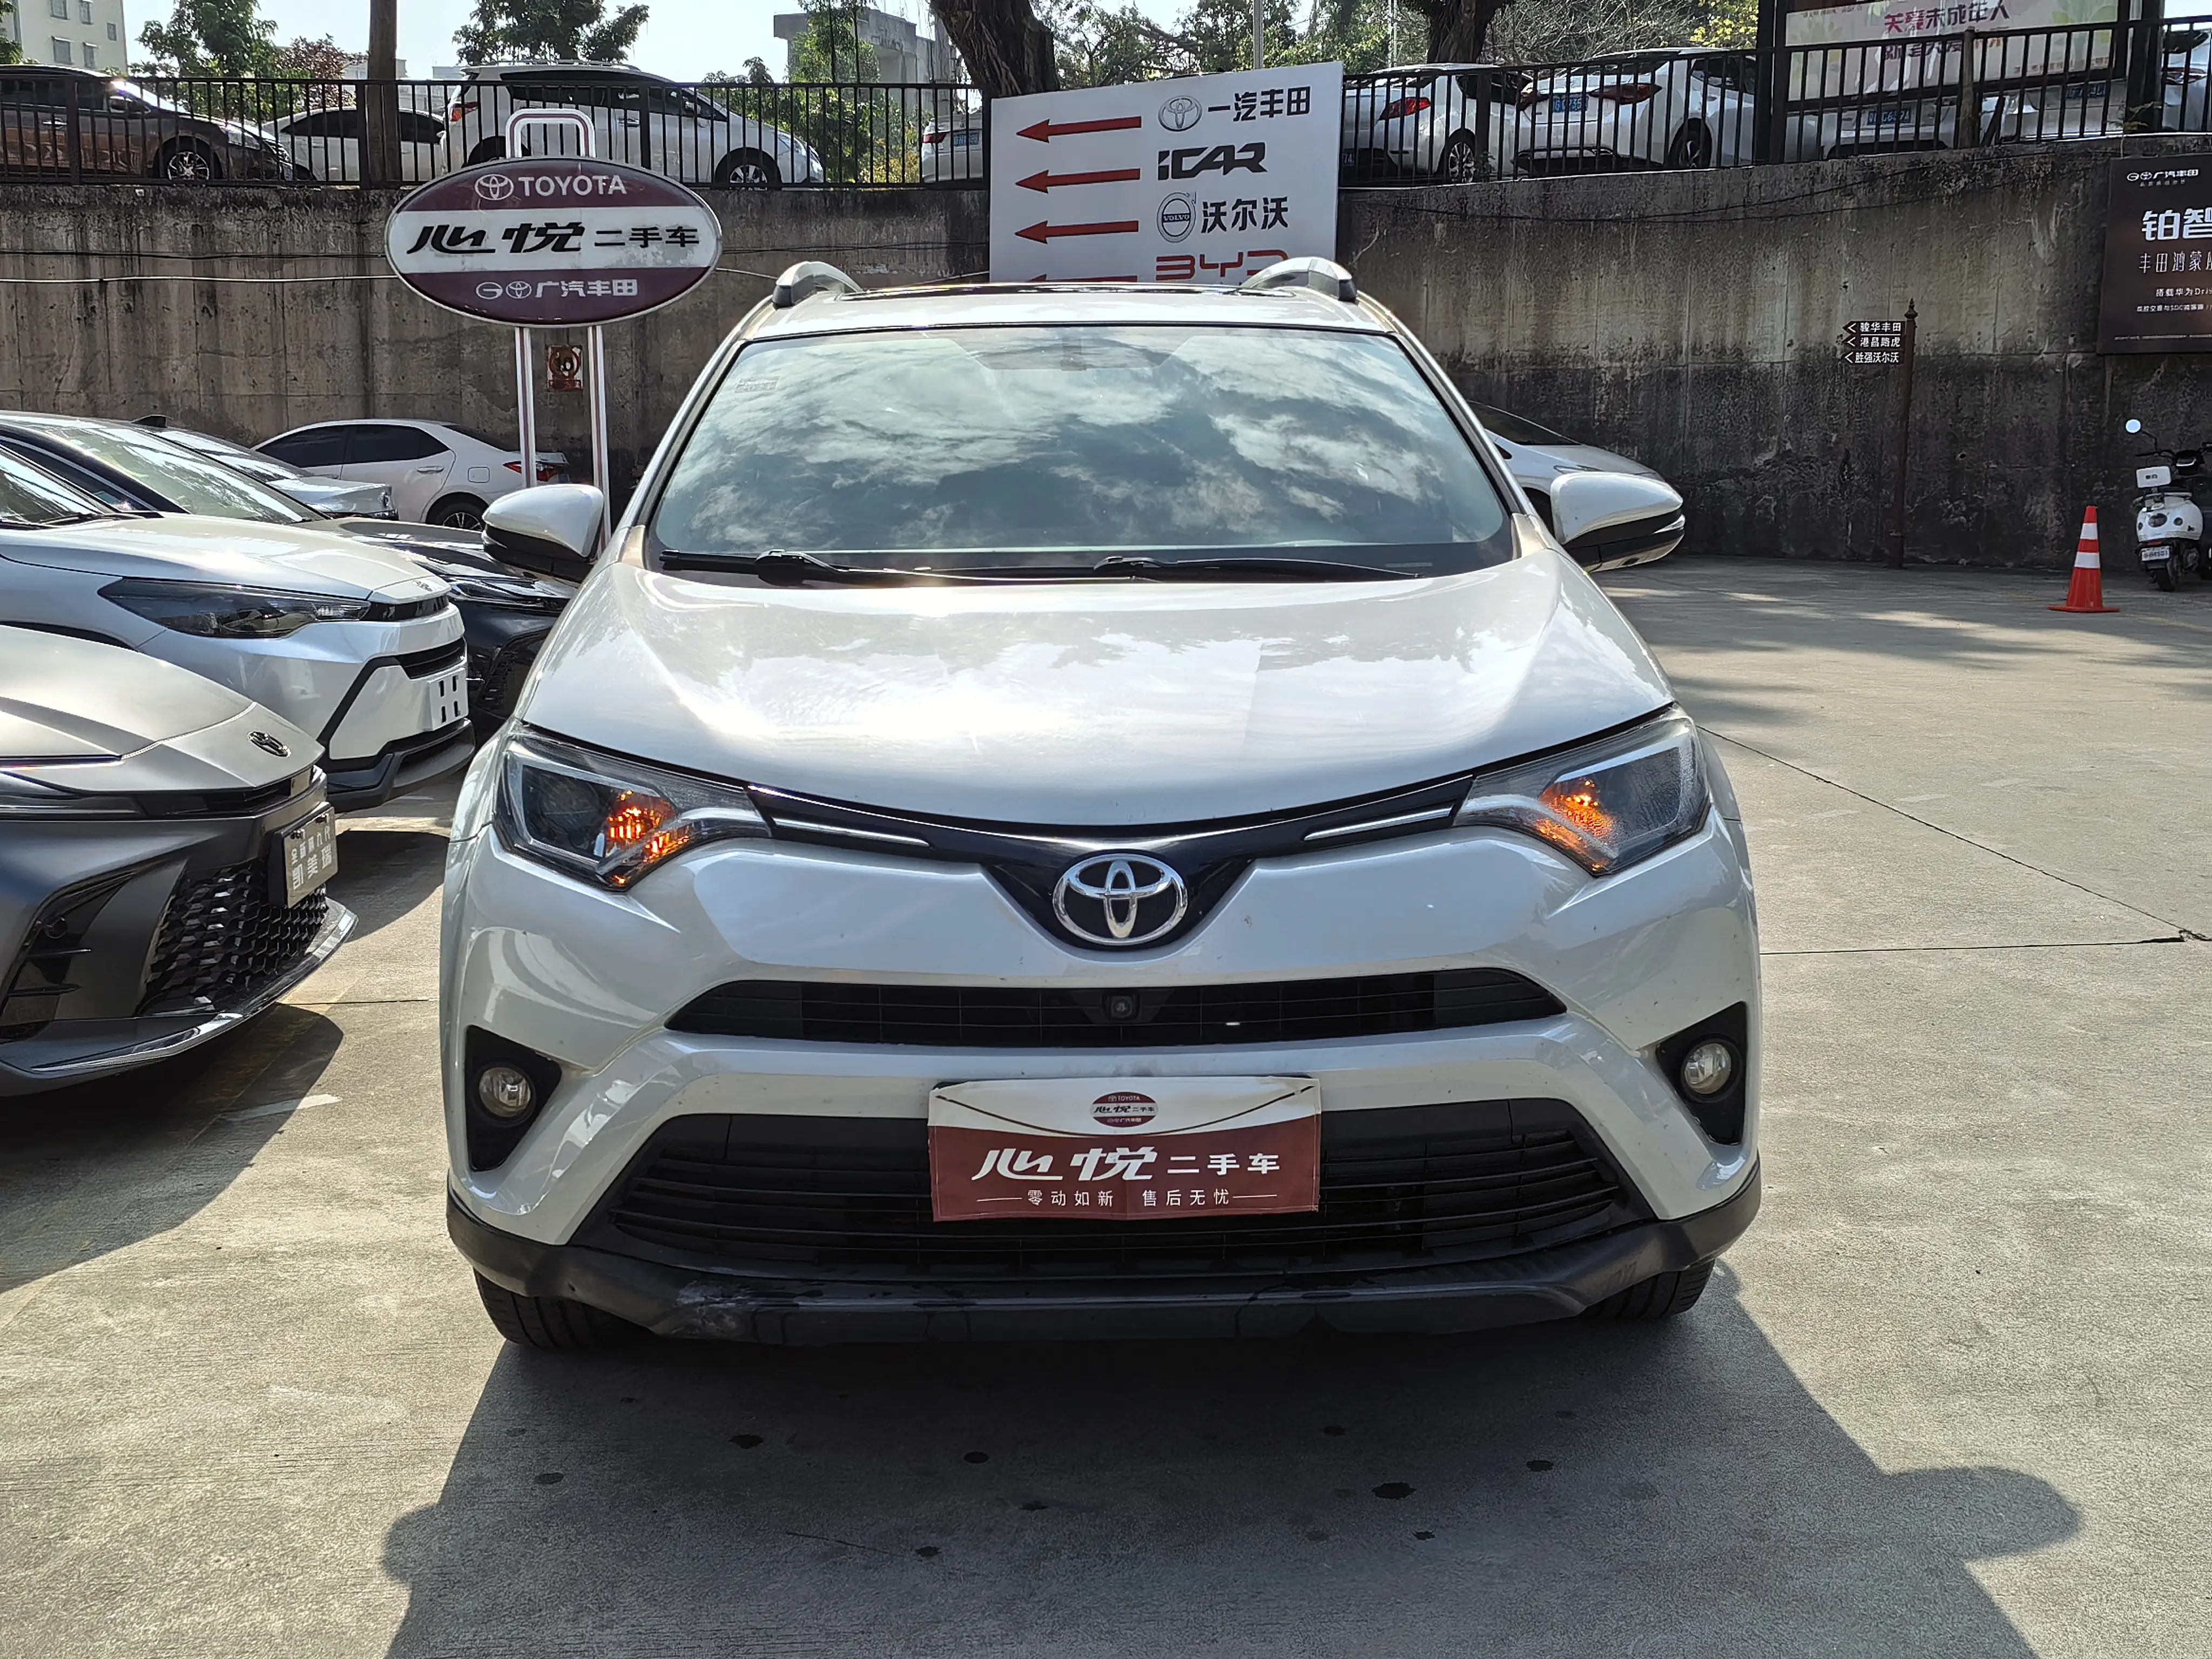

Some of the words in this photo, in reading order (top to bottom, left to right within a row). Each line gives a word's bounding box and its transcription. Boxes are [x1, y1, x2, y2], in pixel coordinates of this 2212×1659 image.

[1208, 86, 1311, 122] 一汽丰田
[518, 174, 627, 197] TOYOTA
[1201, 196, 1289, 234] 沃尔沃
[535, 279, 638, 298] 广汽丰田
[1027, 1190, 1113, 1206] 零动如新
[1142, 1189, 1229, 1206] 售后无忧
